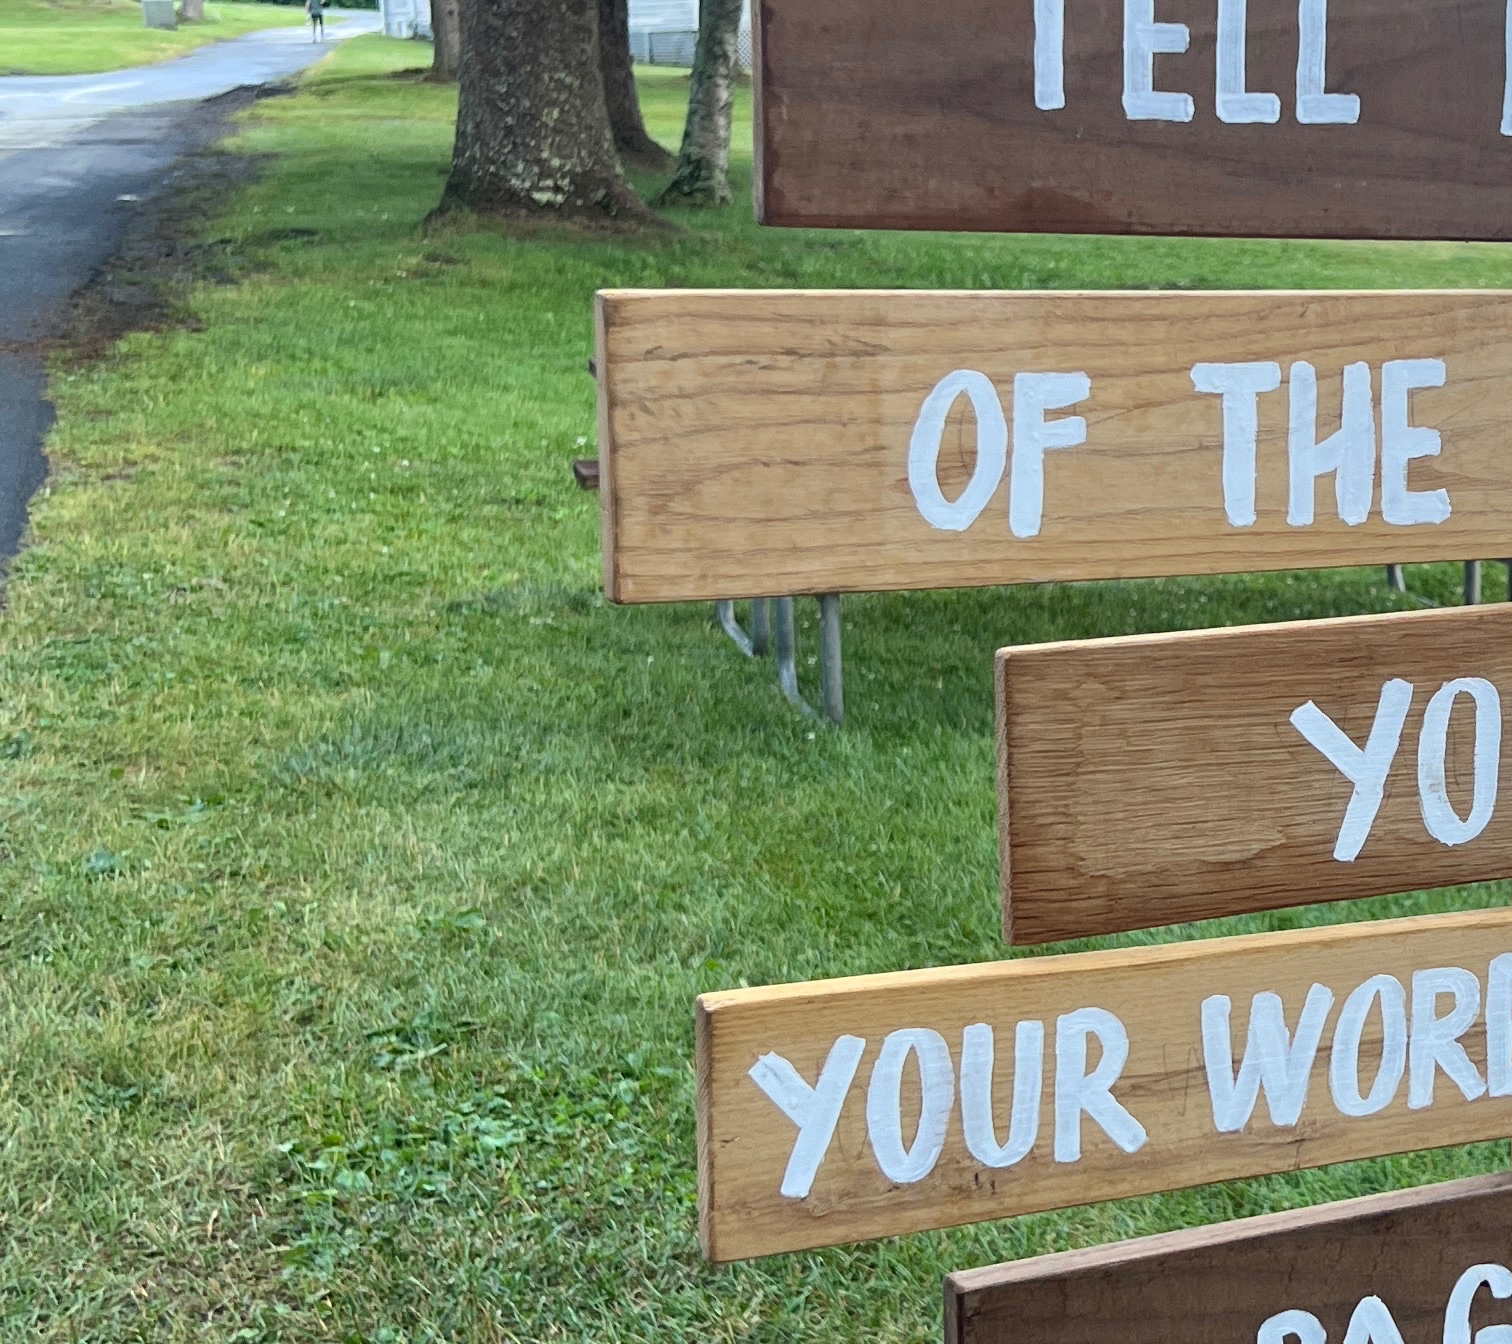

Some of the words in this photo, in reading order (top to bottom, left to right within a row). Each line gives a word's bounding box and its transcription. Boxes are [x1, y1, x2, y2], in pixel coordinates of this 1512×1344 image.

[906, 368, 1091, 537] OF
[1190, 357, 1453, 527] THE
[747, 1006, 1148, 1199] YOUR
